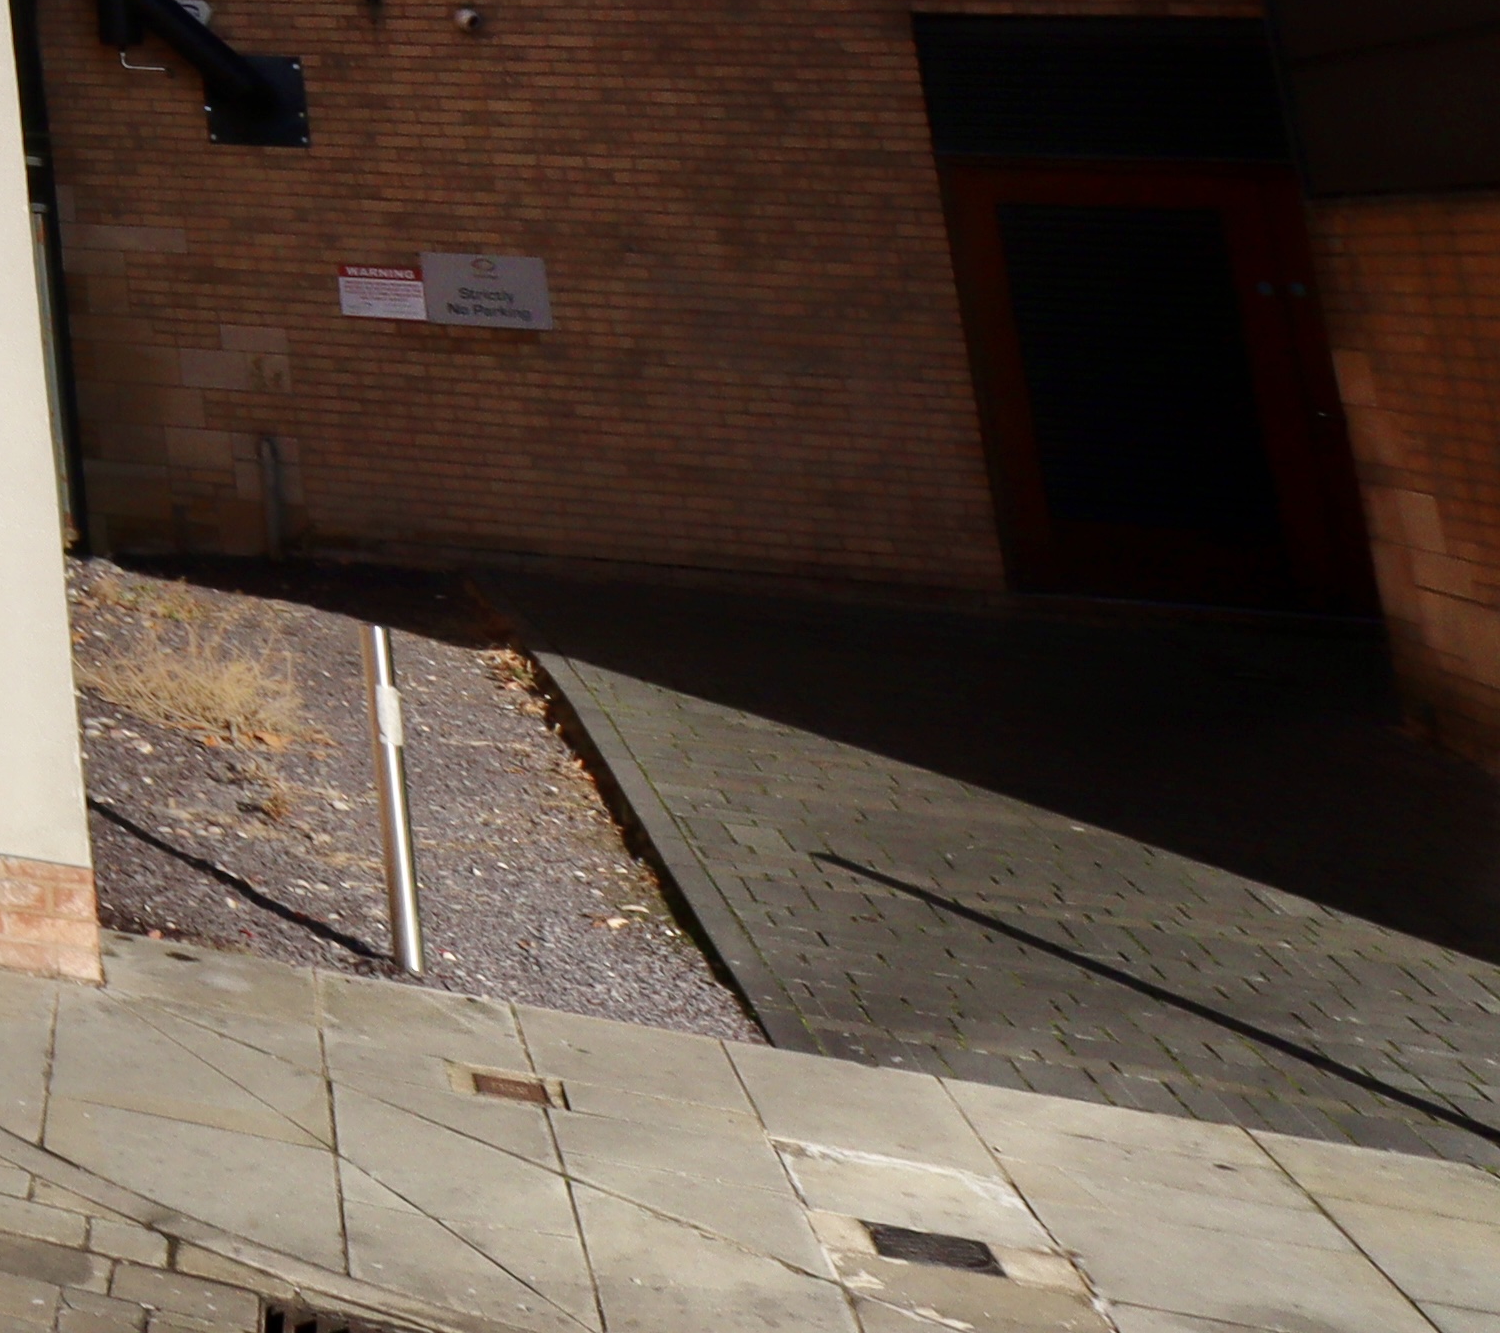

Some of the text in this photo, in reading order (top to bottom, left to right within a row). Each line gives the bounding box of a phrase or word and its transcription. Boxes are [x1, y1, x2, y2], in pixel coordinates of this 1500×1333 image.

[345, 266, 416, 280] WARNING
[458, 287, 515, 304] Strictly
[447, 302, 532, 322] No Parking
